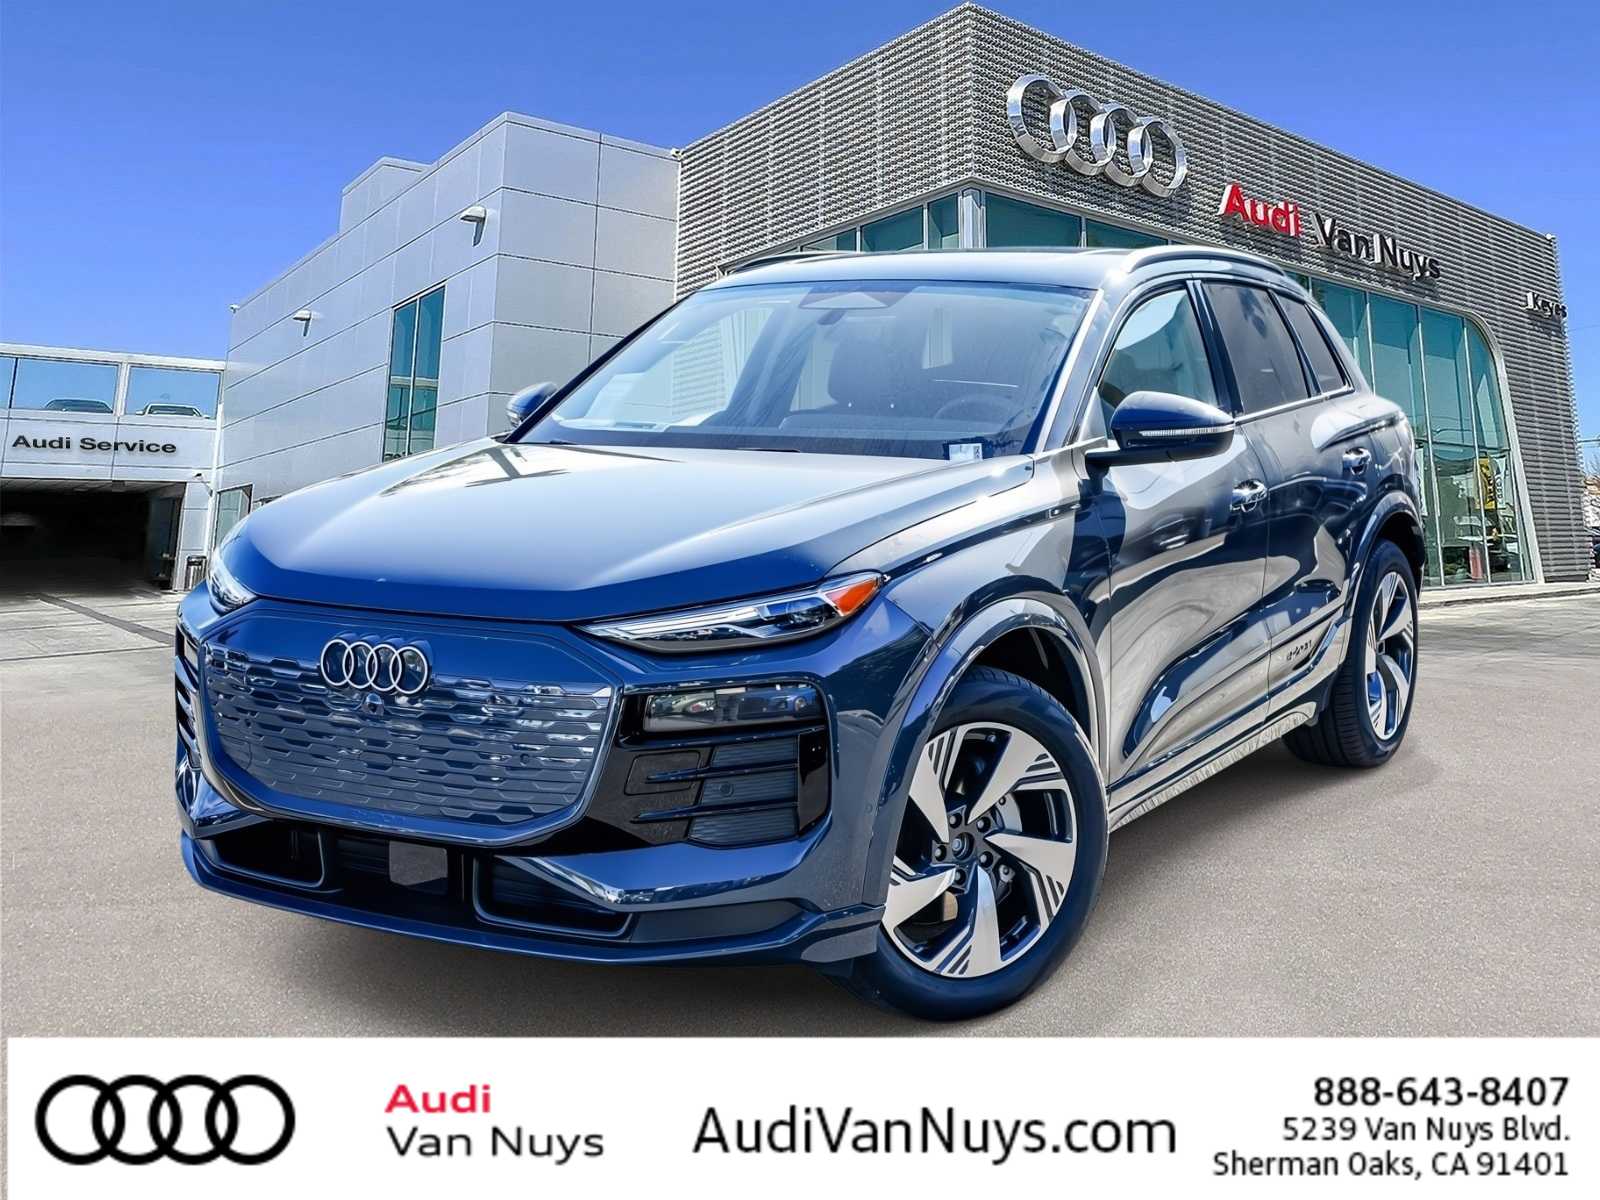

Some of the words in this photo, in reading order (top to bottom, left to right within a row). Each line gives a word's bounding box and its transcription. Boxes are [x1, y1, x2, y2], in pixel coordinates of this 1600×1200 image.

[1217, 182, 1303, 237] Audi
[1311, 211, 1370, 259] Van
[1373, 233, 1441, 281] Nuys
[12, 434, 71, 450] Audi
[79, 436, 177, 454] Service
